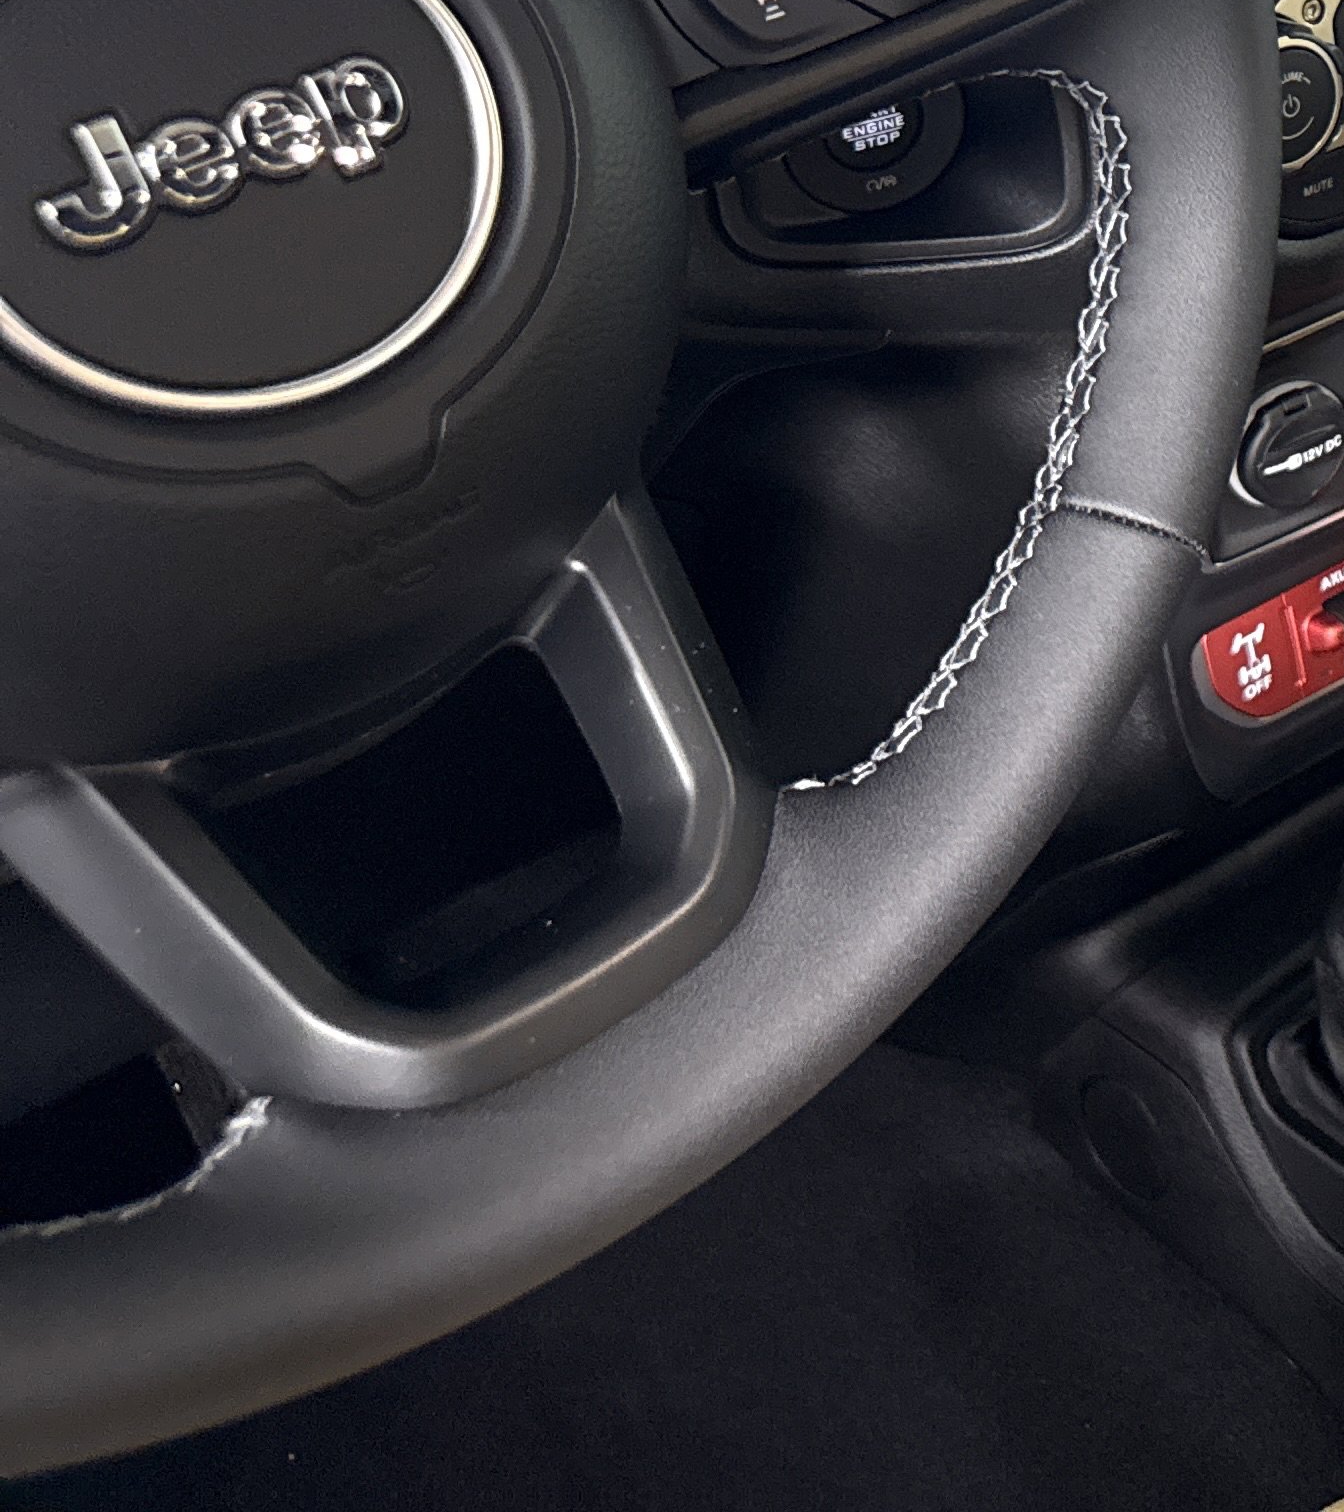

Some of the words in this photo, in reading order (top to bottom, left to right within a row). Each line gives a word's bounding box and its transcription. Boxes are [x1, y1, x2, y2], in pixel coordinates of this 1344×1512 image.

[842, 113, 906, 140] ENGINE
[35, 54, 406, 250] Jeep
[854, 130, 901, 152] STOP
[1303, 176, 1333, 197] MUTE
[1302, 444, 1324, 464] 12V
[1324, 433, 1343, 453] DC
[1243, 673, 1273, 702] OFF
